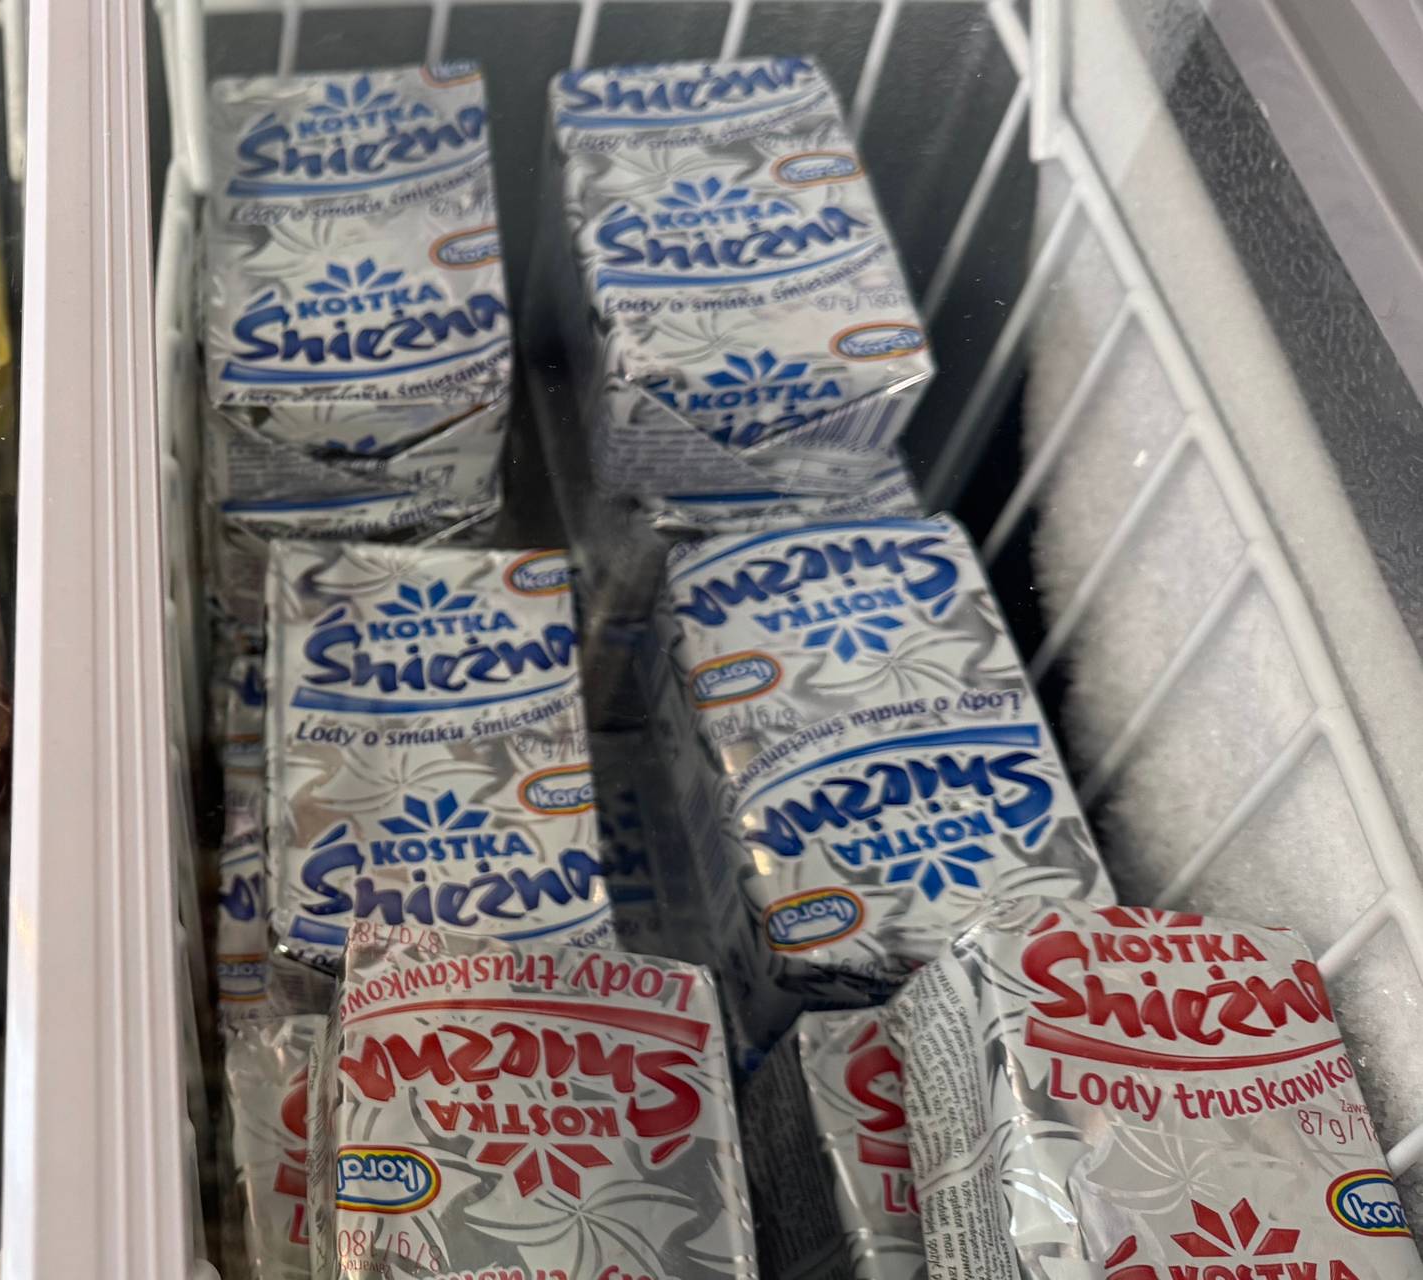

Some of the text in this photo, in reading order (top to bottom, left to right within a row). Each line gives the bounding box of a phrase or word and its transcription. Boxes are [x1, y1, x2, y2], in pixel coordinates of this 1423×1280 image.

[296, 103, 434, 137] KOSTKA
[653, 201, 797, 230] KOSTKA
[295, 284, 443, 320] KOSTKA
[687, 380, 842, 412] KOSTKA
[368, 610, 516, 642] KOSTKA
[753, 586, 904, 632] KOSTKA
[296, 720, 355, 745] Lody
[364, 730, 378, 746] o
[385, 723, 464, 746] smaku
[371, 832, 533, 866] KOSTKA
[831, 809, 997, 867] KOSTKA
[1090, 932, 1266, 965] KOSTKA
[572, 952, 696, 1013] Lody
[1051, 1055, 1354, 1122] Lody truskawko
[426, 1099, 620, 1137] KOSTKA
